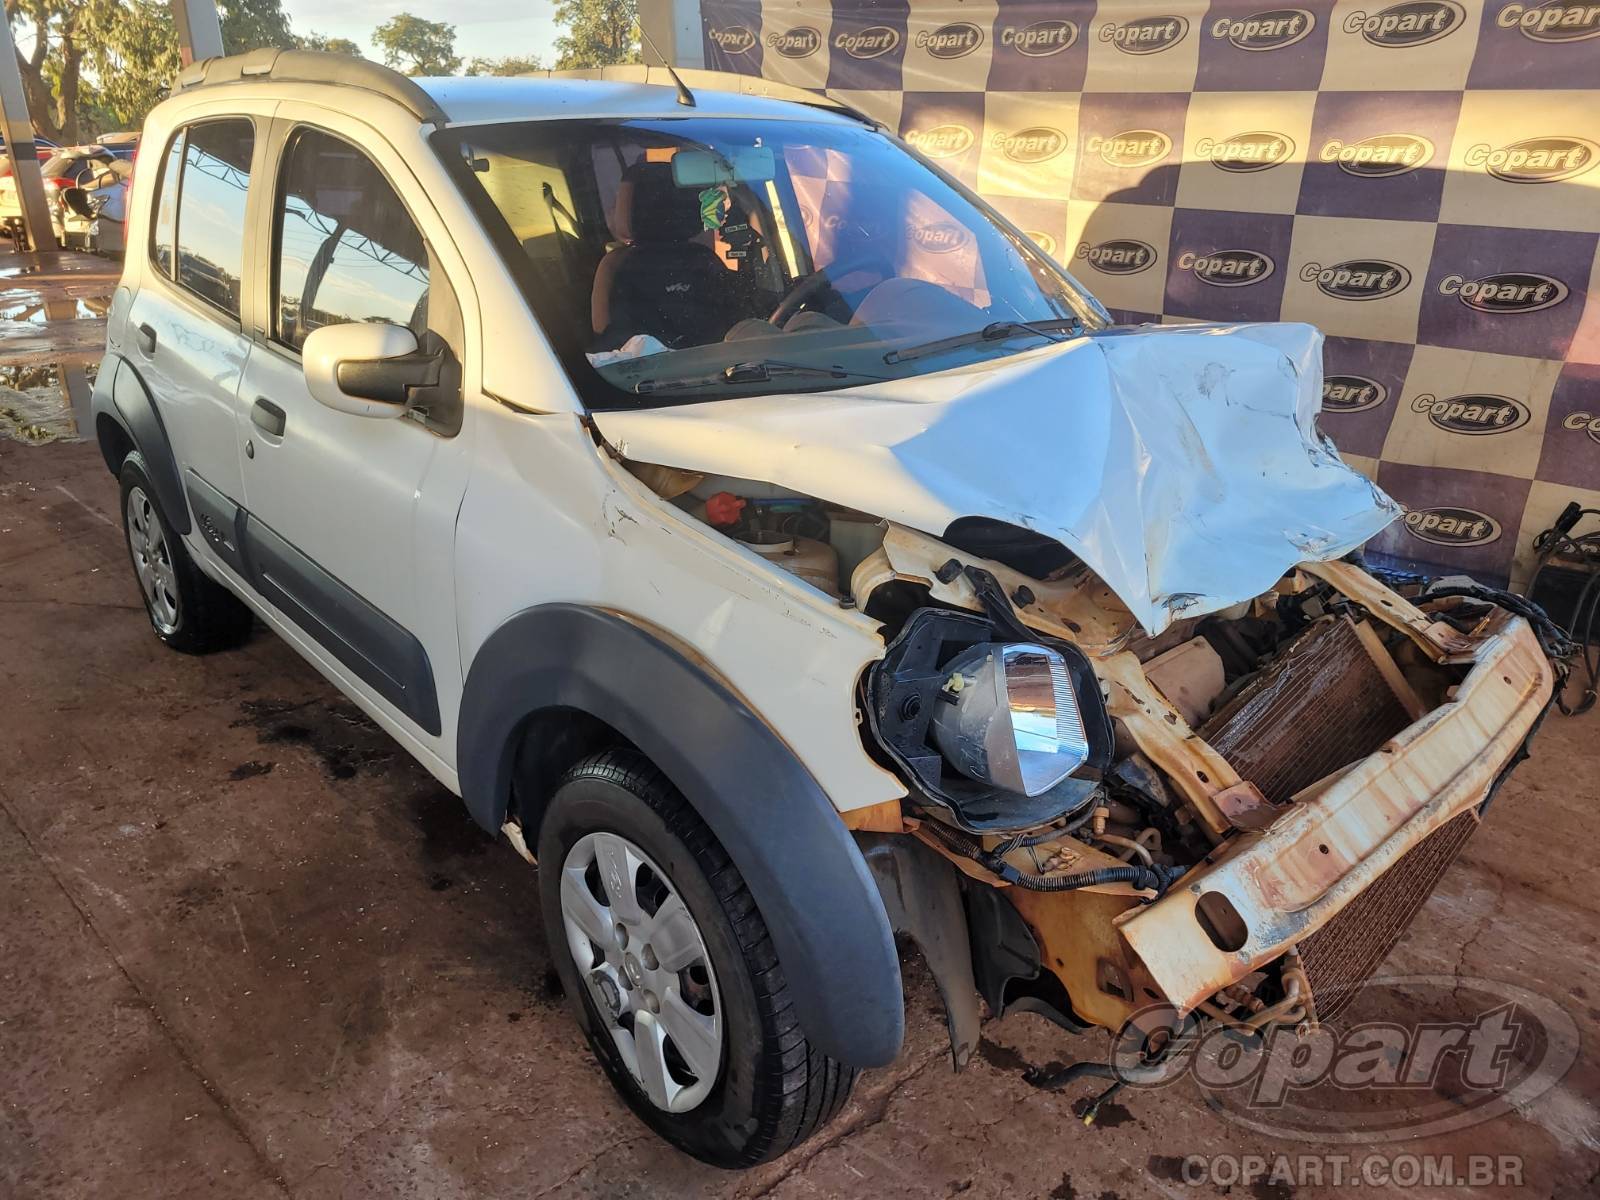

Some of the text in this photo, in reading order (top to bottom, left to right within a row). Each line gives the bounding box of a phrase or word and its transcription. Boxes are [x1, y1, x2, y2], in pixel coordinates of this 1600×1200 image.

[1211, 14, 1302, 44] Copart
[1342, 7, 1448, 42] Copart
[1496, 3, 1600, 32] Copar
[708, 28, 749, 46] Copart
[767, 32, 814, 50] Copart
[835, 25, 891, 49] Copart
[915, 23, 973, 49] Copart
[1001, 21, 1069, 48] Copart
[1099, 19, 1176, 47] Copart
[905, 130, 965, 153] Copart
[991, 132, 1057, 156] Copart
[1086, 134, 1163, 159] Copart
[1195, 138, 1282, 164] Copart
[1319, 139, 1421, 166] Copart
[1463, 144, 1583, 171] Copart
[1077, 241, 1145, 266] Copart
[1178, 252, 1264, 278] Copart
[1300, 262, 1395, 292] Copart
[1438, 274, 1552, 304] Copart
[1411, 394, 1515, 425] Copart
